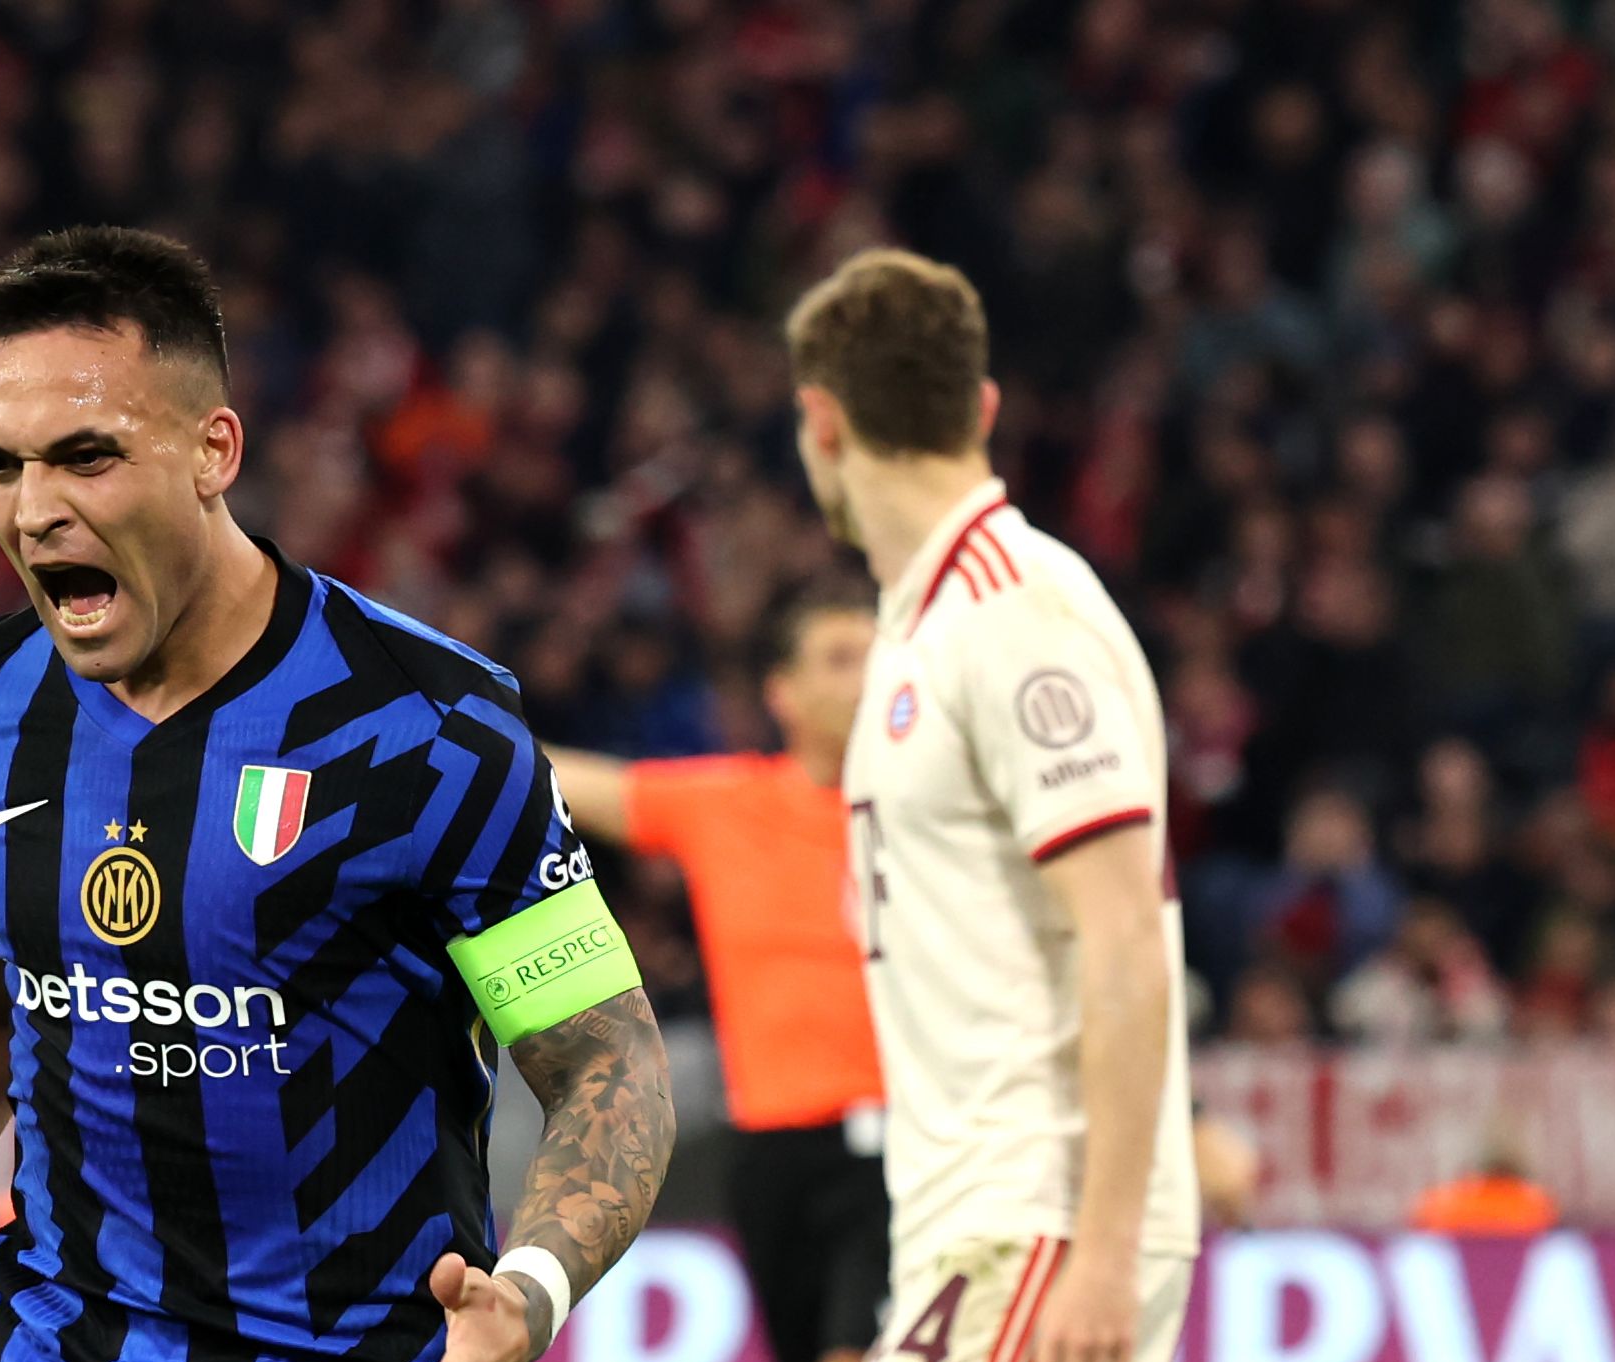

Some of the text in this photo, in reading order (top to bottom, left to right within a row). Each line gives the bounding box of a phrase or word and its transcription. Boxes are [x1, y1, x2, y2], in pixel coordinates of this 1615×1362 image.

[516, 925, 615, 986] RESPECT
[16, 962, 286, 1028] betsson
[115, 1033, 292, 1087] .sport
